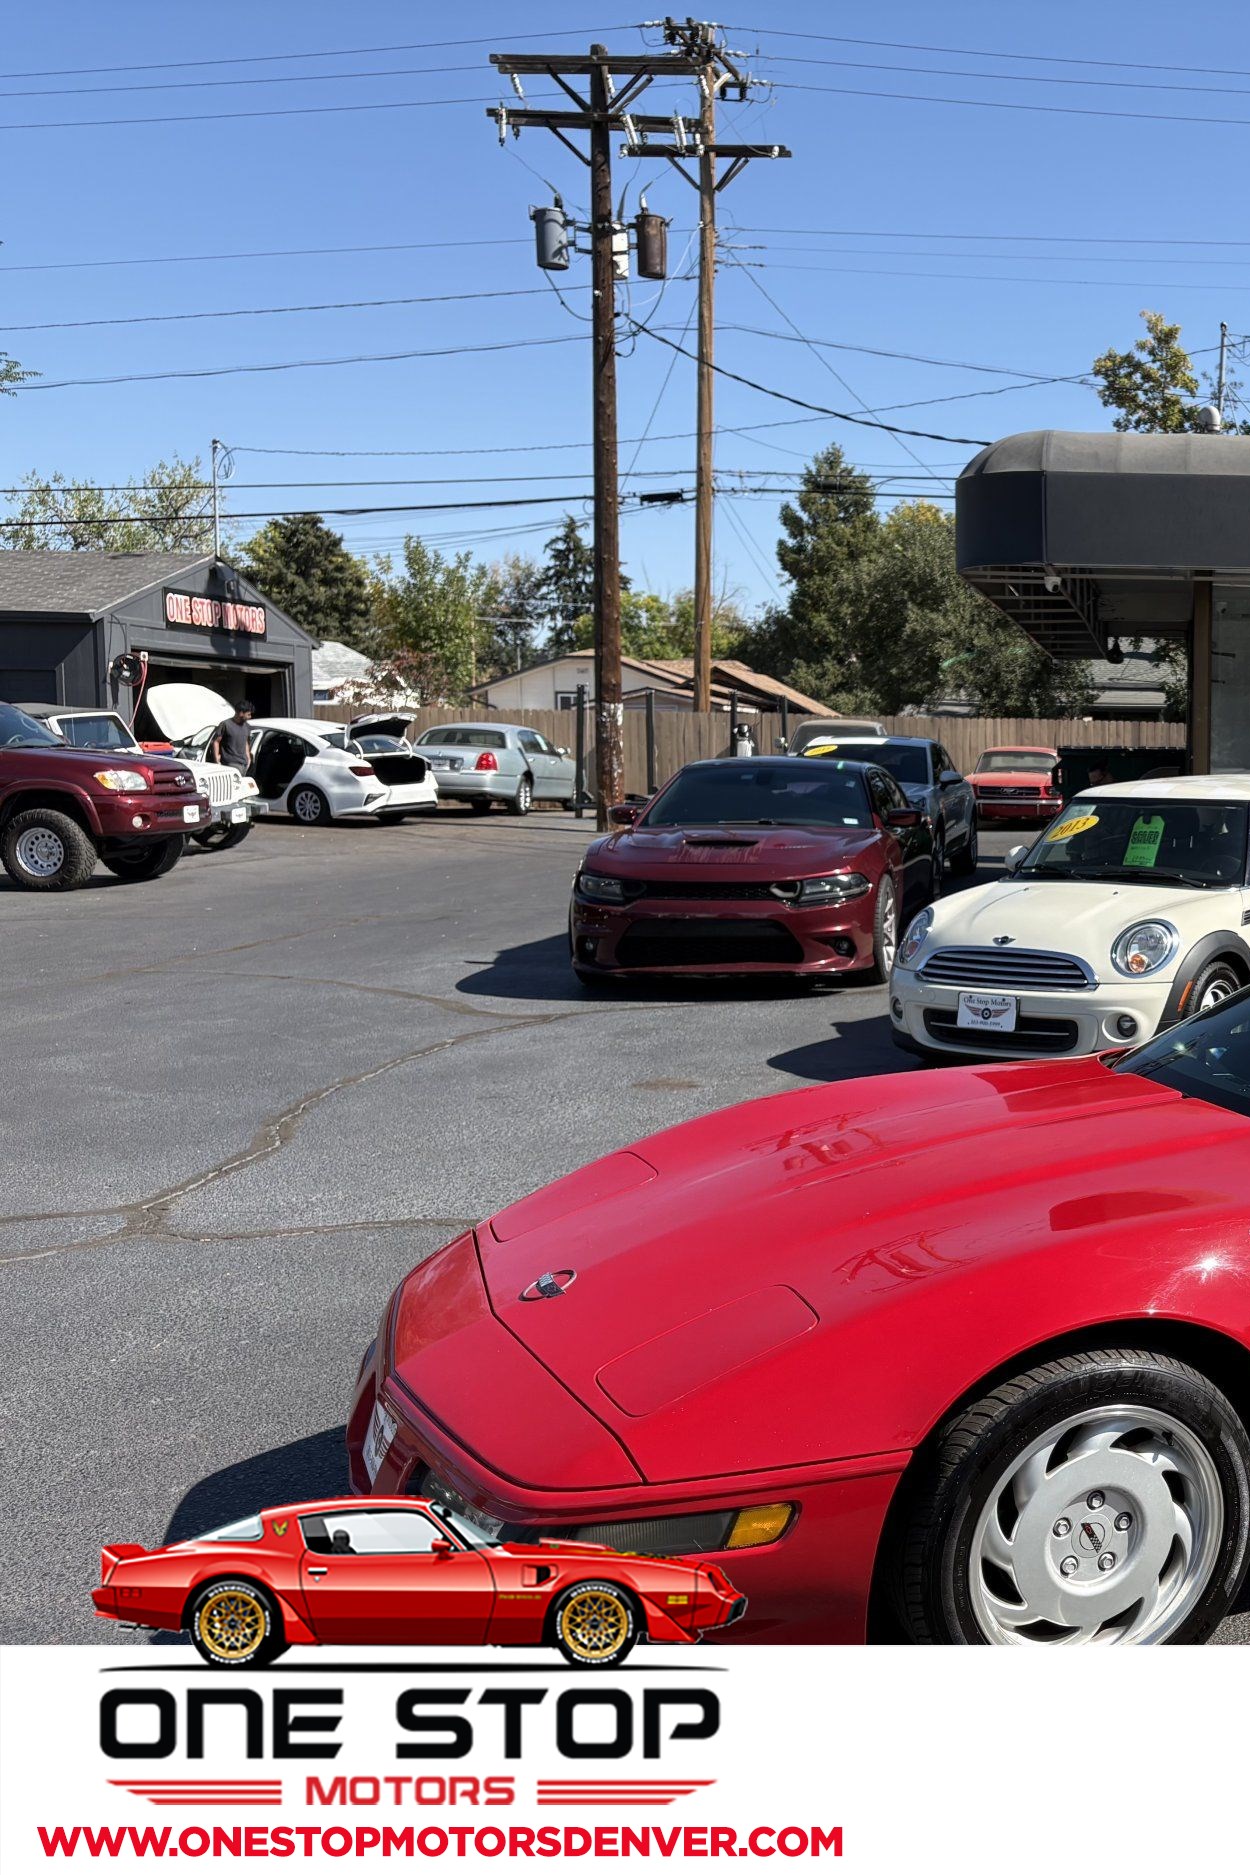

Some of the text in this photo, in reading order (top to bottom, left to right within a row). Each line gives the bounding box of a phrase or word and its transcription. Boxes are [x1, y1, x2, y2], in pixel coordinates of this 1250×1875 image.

[166, 592, 266, 634] ONE STOP MOTORS
[1050, 817, 1091, 840] 2013
[976, 998, 990, 1006] Stop
[990, 999, 1012, 1007] Motors
